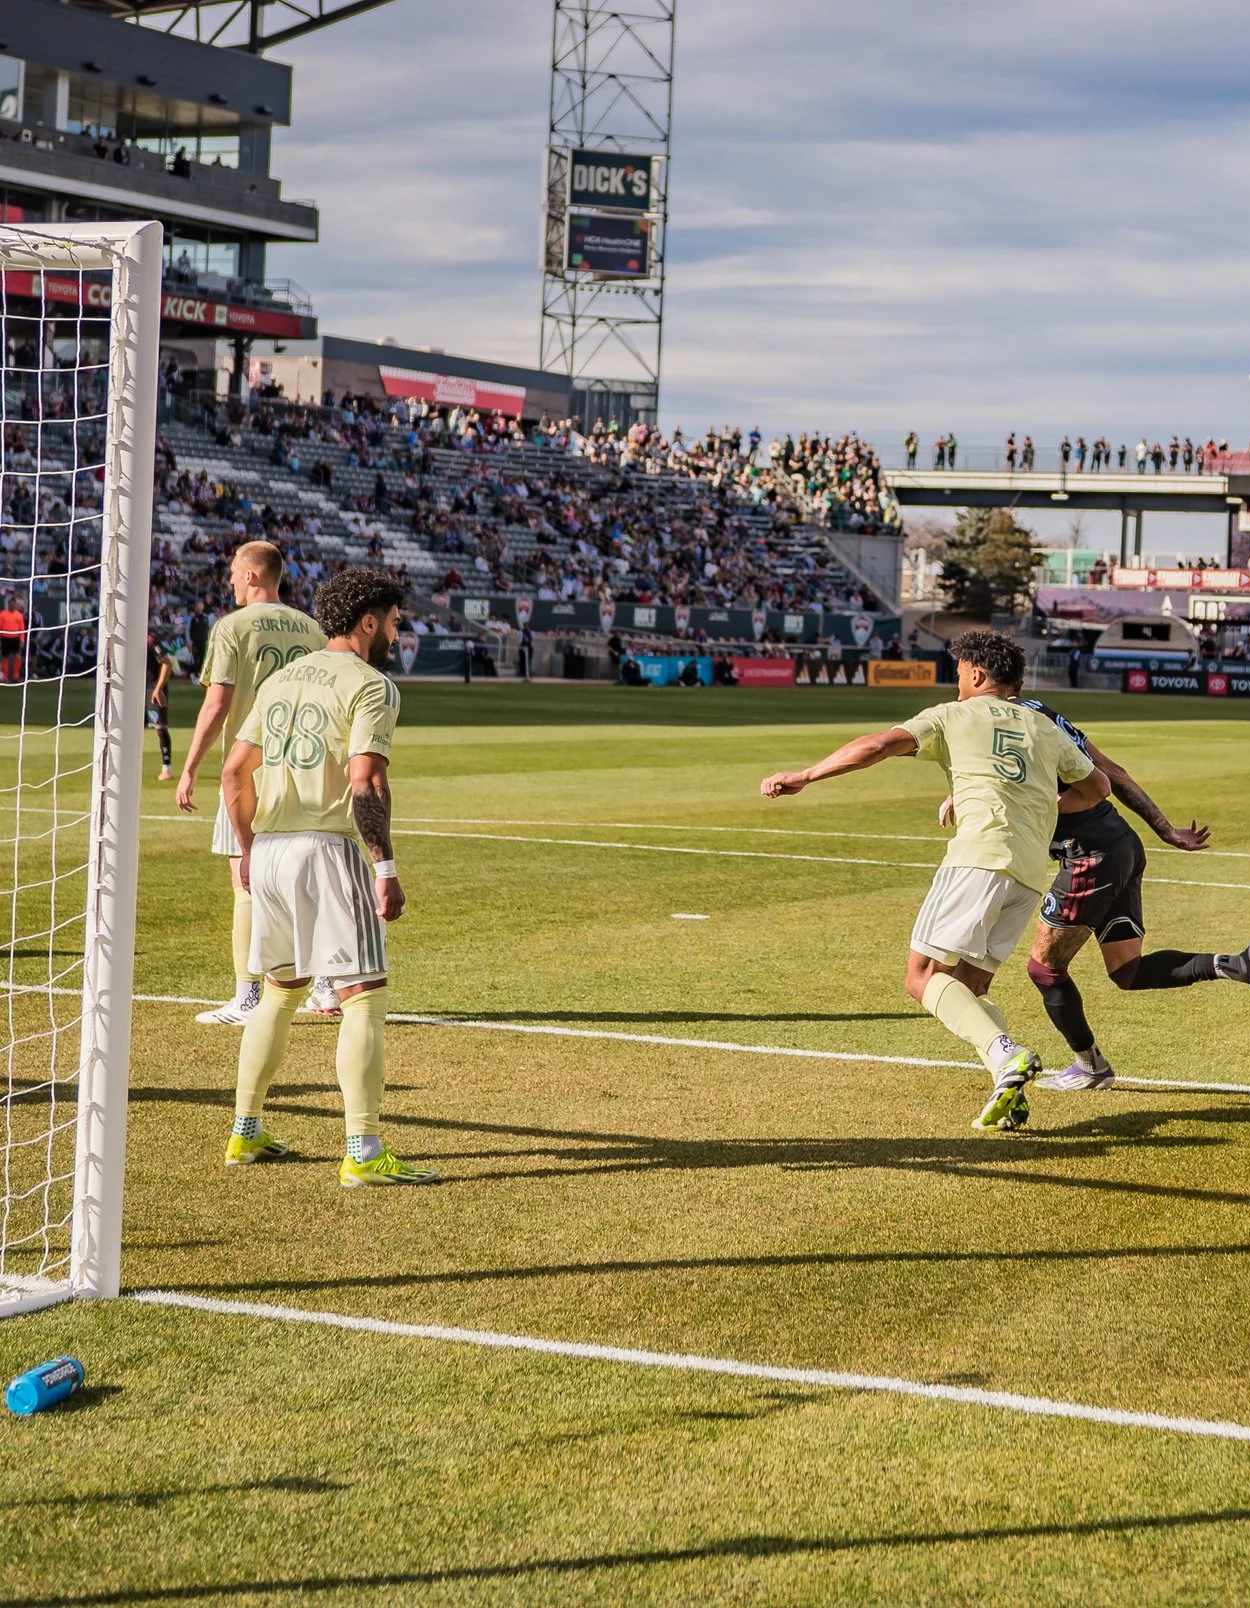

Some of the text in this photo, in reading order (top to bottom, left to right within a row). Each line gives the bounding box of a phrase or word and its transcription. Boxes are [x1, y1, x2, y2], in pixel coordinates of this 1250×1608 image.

[573, 164, 648, 197] DICK'S
[48, 280, 78, 297] TOYOTA
[164, 295, 207, 322] KICK
[229, 311, 255, 325] TOYOTA
[251, 618, 310, 635] SURMAN
[278, 665, 338, 689] GUERRA
[1151, 676, 1199, 689] TOYOTA
[988, 706, 1022, 721] BYE
[265, 700, 329, 770] 88
[992, 727, 1027, 784] 5
